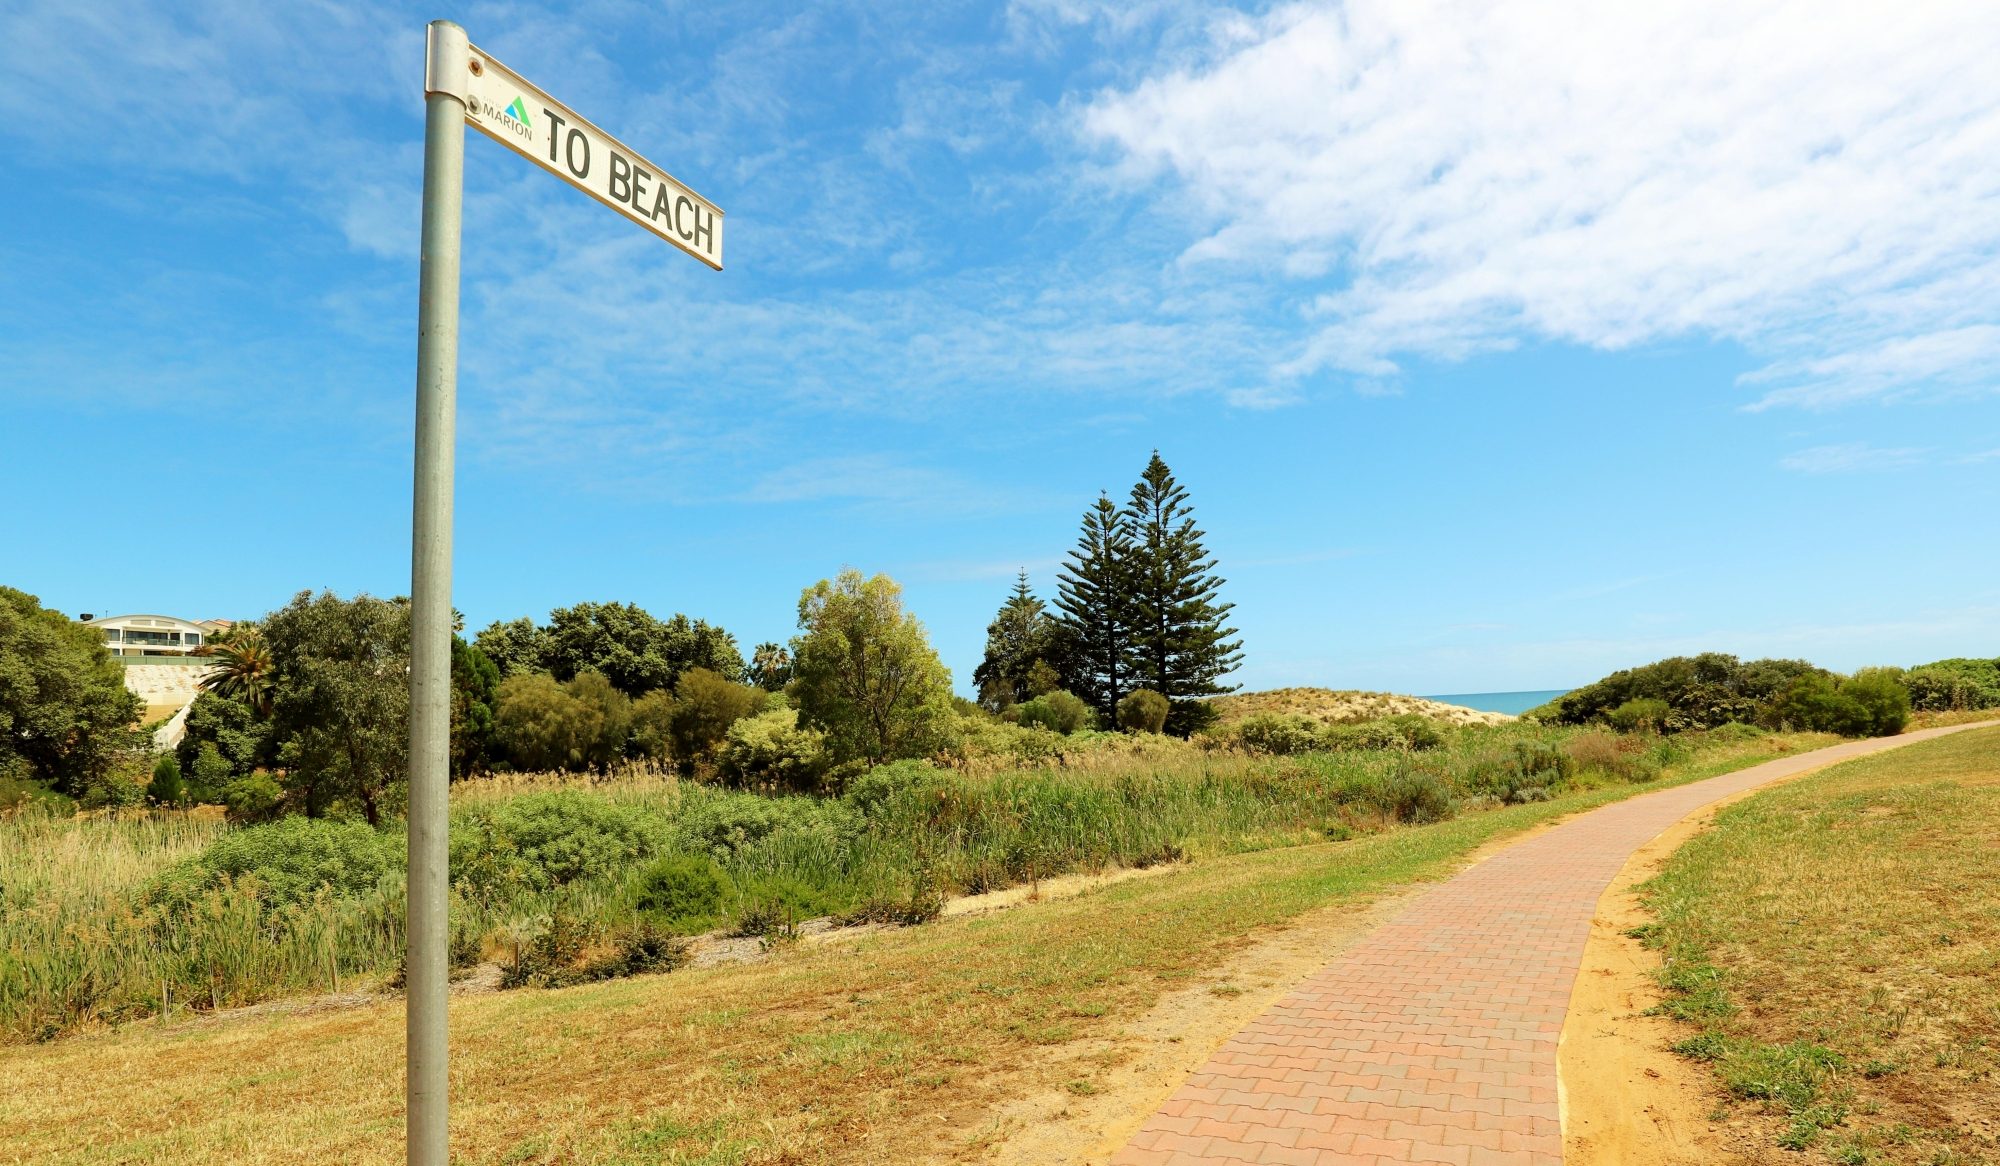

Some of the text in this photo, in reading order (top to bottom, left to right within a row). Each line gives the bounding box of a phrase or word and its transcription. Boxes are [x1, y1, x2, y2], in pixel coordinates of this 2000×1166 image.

[483, 103, 532, 141] MARION
[543, 108, 713, 254] TO BEACH
